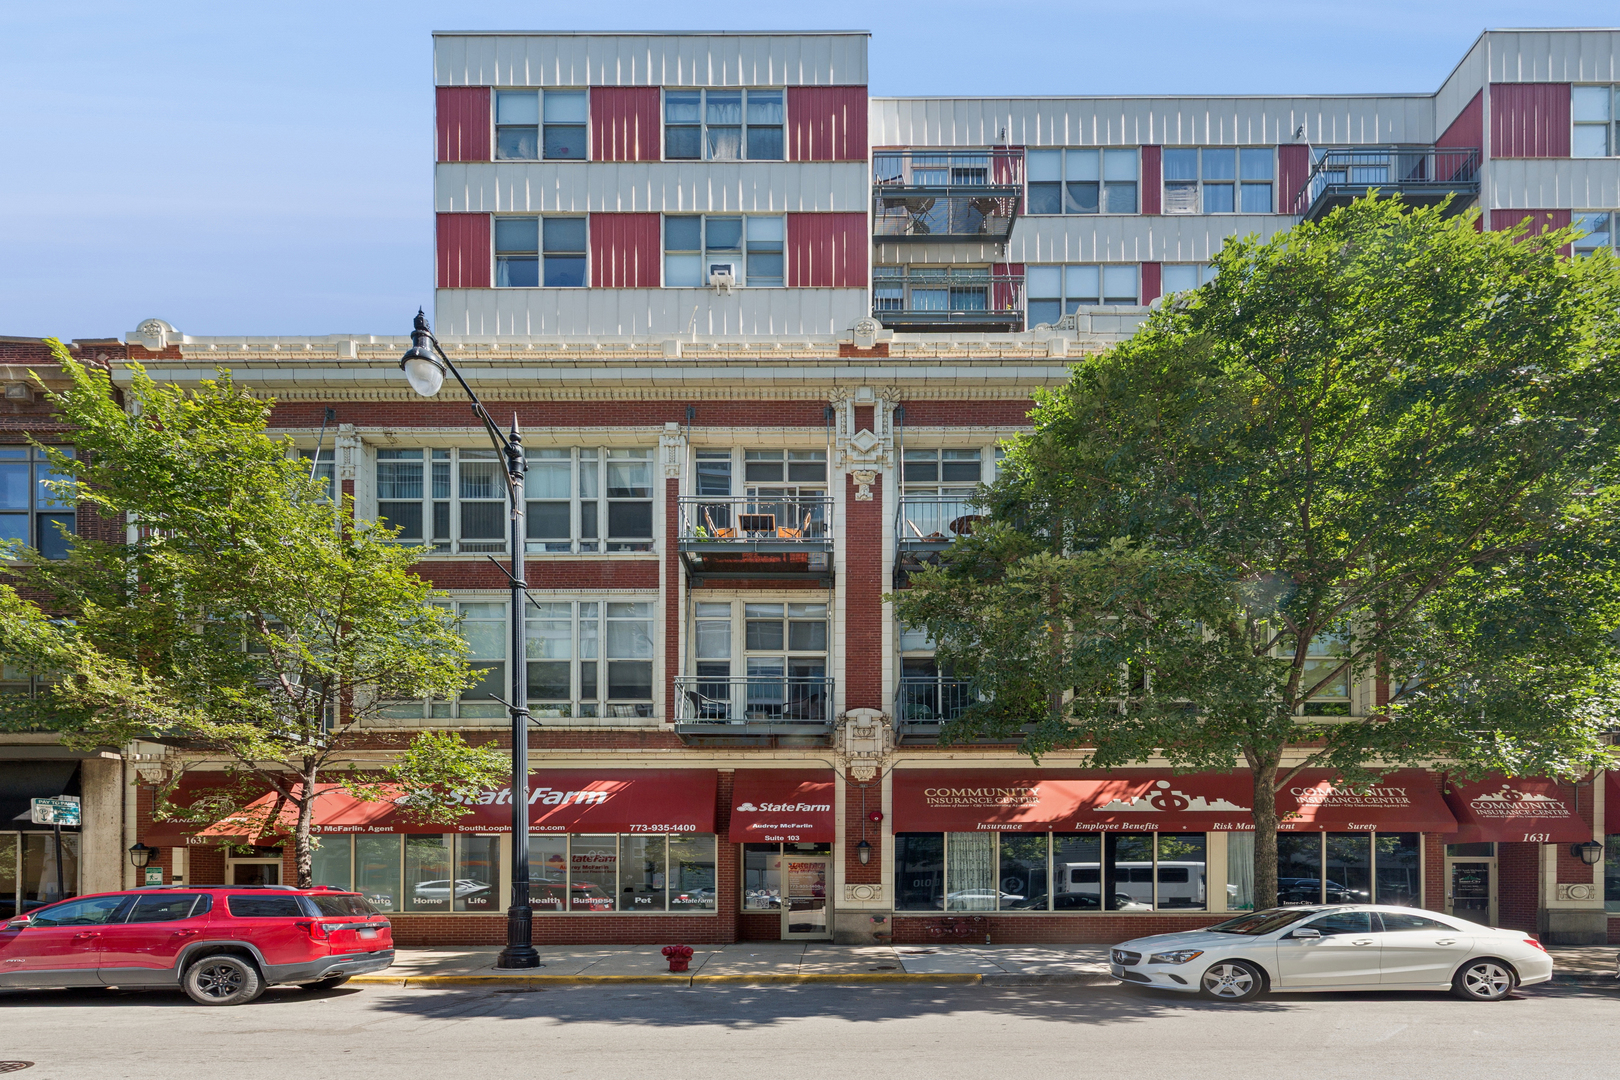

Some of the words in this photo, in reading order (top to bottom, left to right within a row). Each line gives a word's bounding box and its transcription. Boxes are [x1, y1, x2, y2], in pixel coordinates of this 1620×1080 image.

[444, 787, 608, 805] StatFarm
[924, 787, 1040, 797] COMMUNITY
[1290, 787, 1407, 796] COMMUNITY
[758, 802, 830, 812] StateFarm
[1470, 802, 1566, 810] COMMUNITY
[1075, 822, 1119, 831] Employee
[1122, 822, 1159, 831] Benefits
[1347, 822, 1377, 832] Surety
[1523, 833, 1550, 842] 1631
